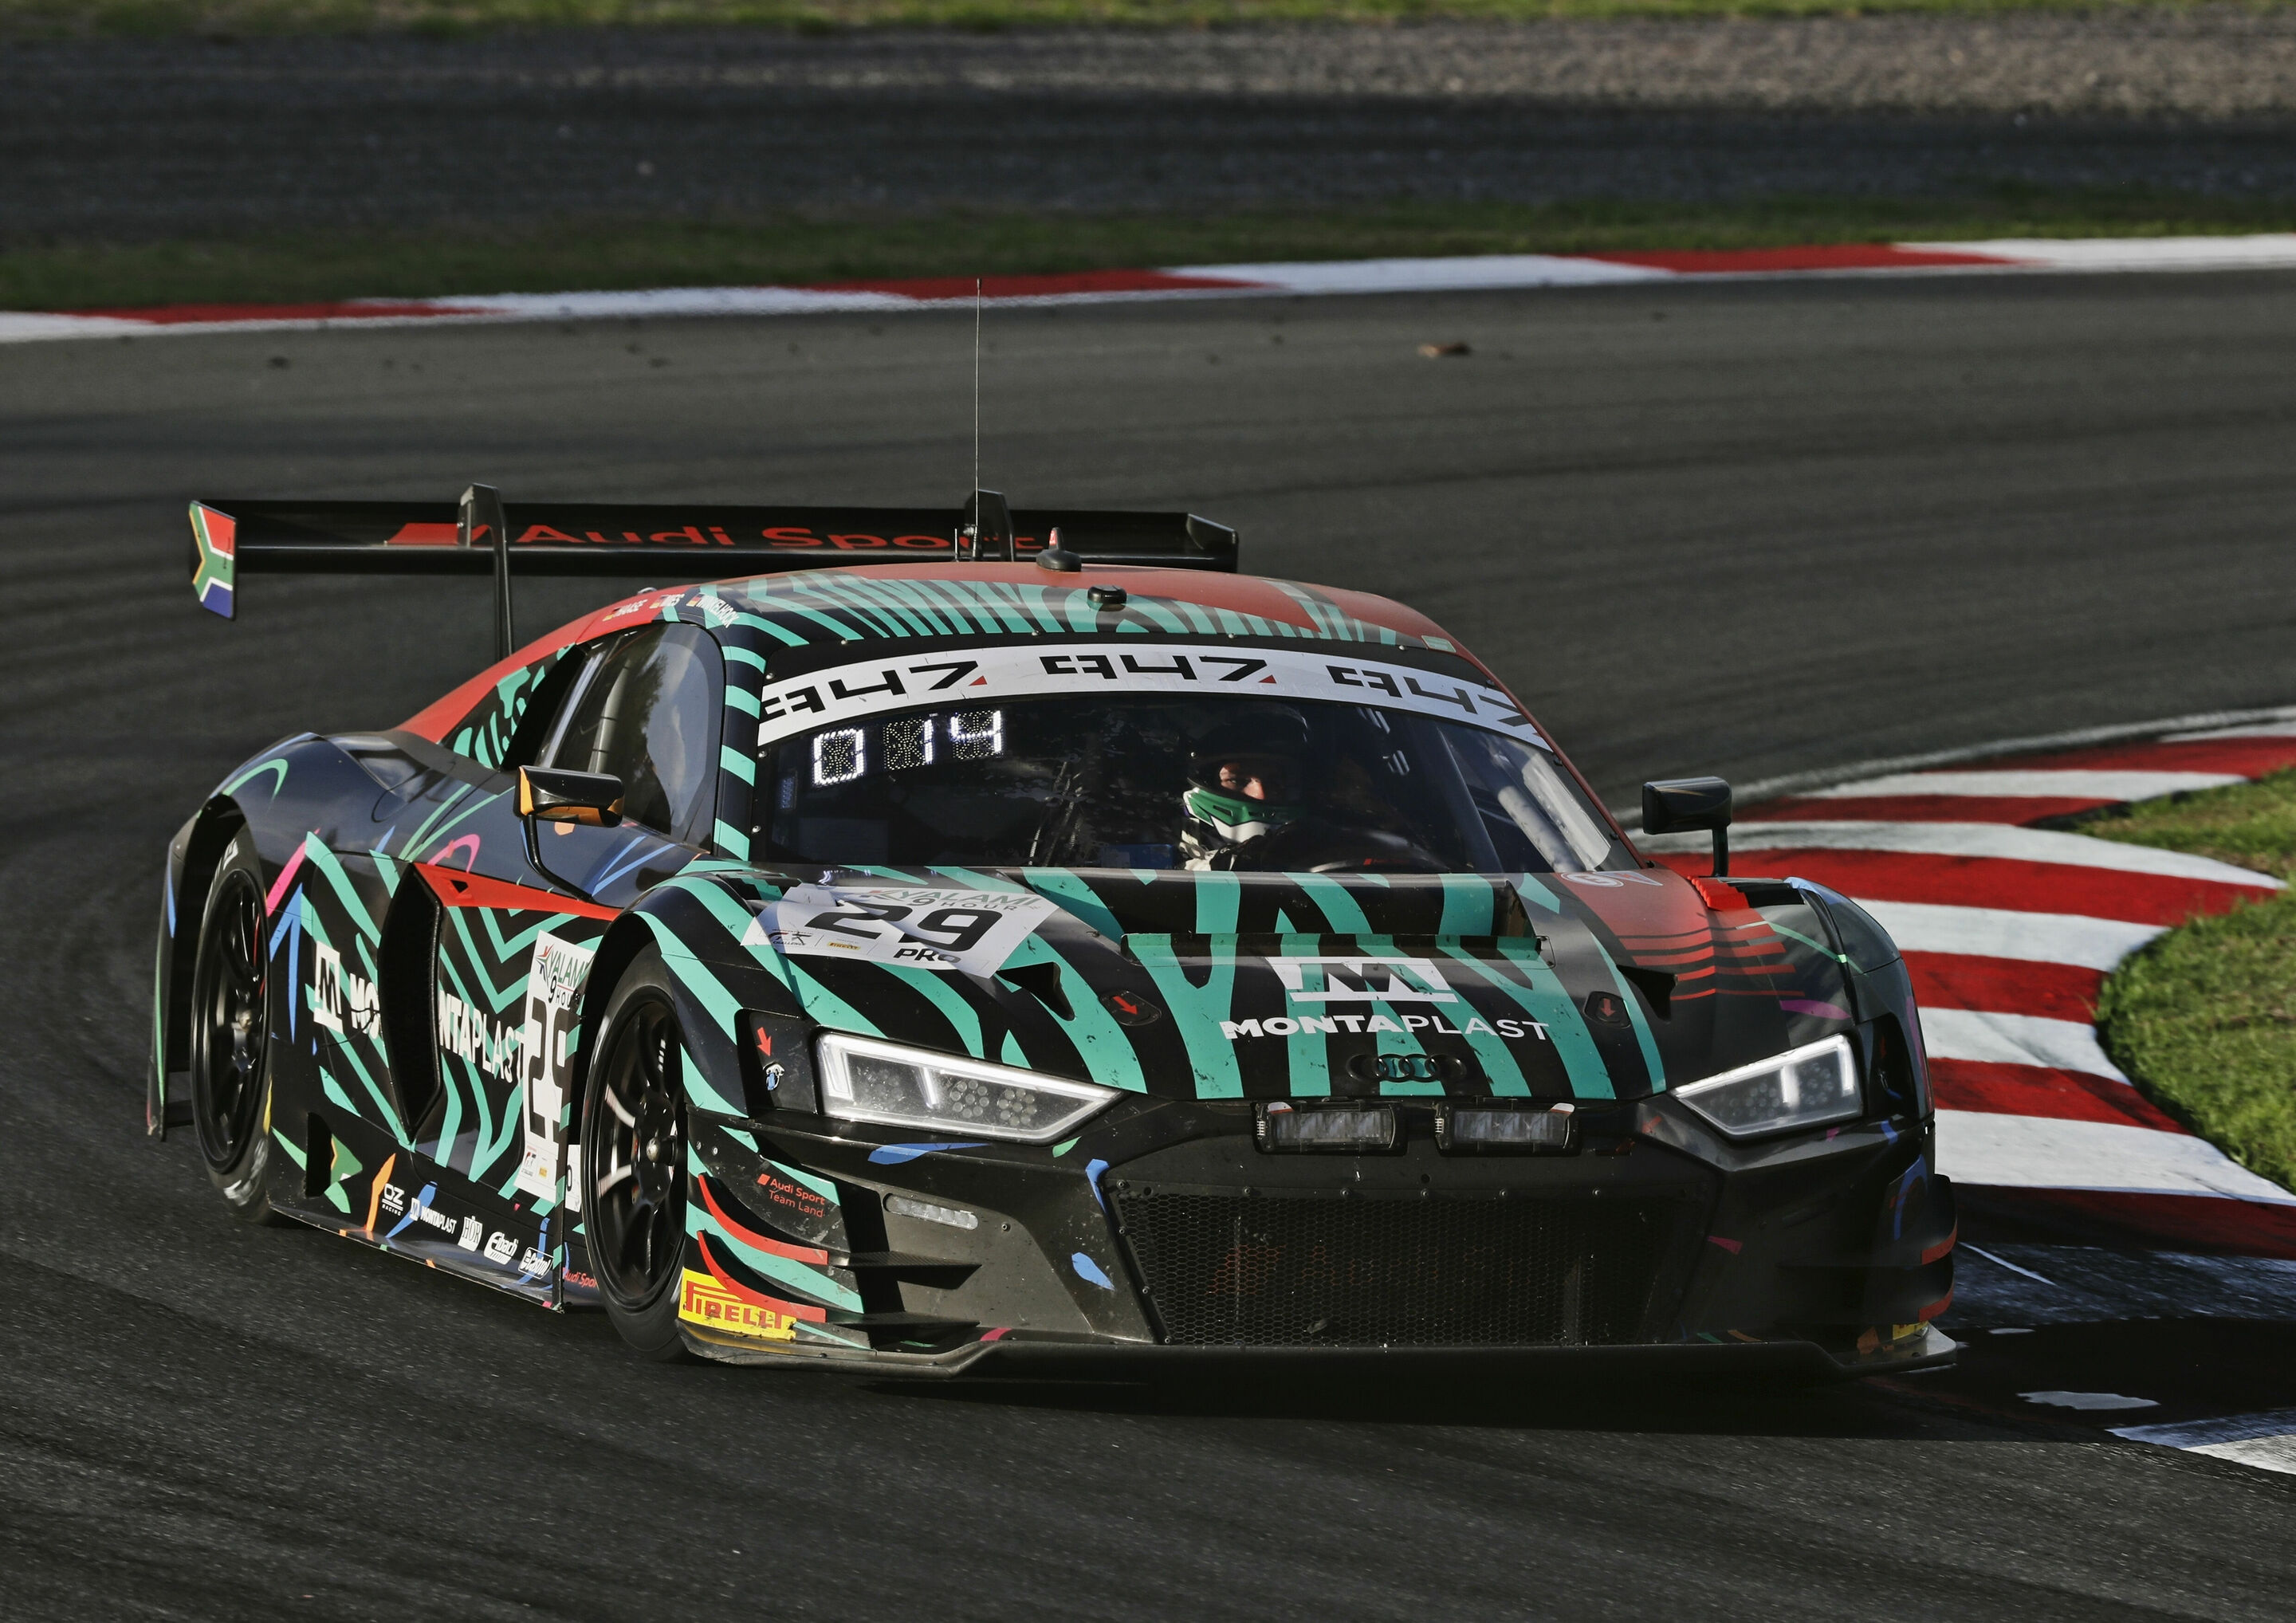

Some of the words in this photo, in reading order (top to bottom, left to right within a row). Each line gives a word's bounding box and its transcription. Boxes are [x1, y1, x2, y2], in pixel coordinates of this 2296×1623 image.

[516, 524, 736, 546] Audi
[1039, 654, 1268, 682] 947
[907, 898, 936, 906] 9
[941, 901, 1018, 911] HOUR
[804, 900, 1003, 953] 29
[536, 943, 590, 988] KYALAM
[892, 948, 961, 964] PRO
[548, 975, 557, 1004] 9
[1219, 1015, 1550, 1041] MONTAPLAST
[383, 1183, 405, 1205] OZ
[769, 1189, 796, 1208] Team
[798, 1201, 824, 1219] Land
[770, 1178, 794, 1194] Audi
[796, 1187, 826, 1206] Sport
[381, 1204, 402, 1216] RACING
[420, 1205, 458, 1235] MONTAPLAST
[564, 1271, 581, 1283] Audi
[578, 1273, 597, 1288] Spor
[686, 1280, 782, 1330] PIRELLI
